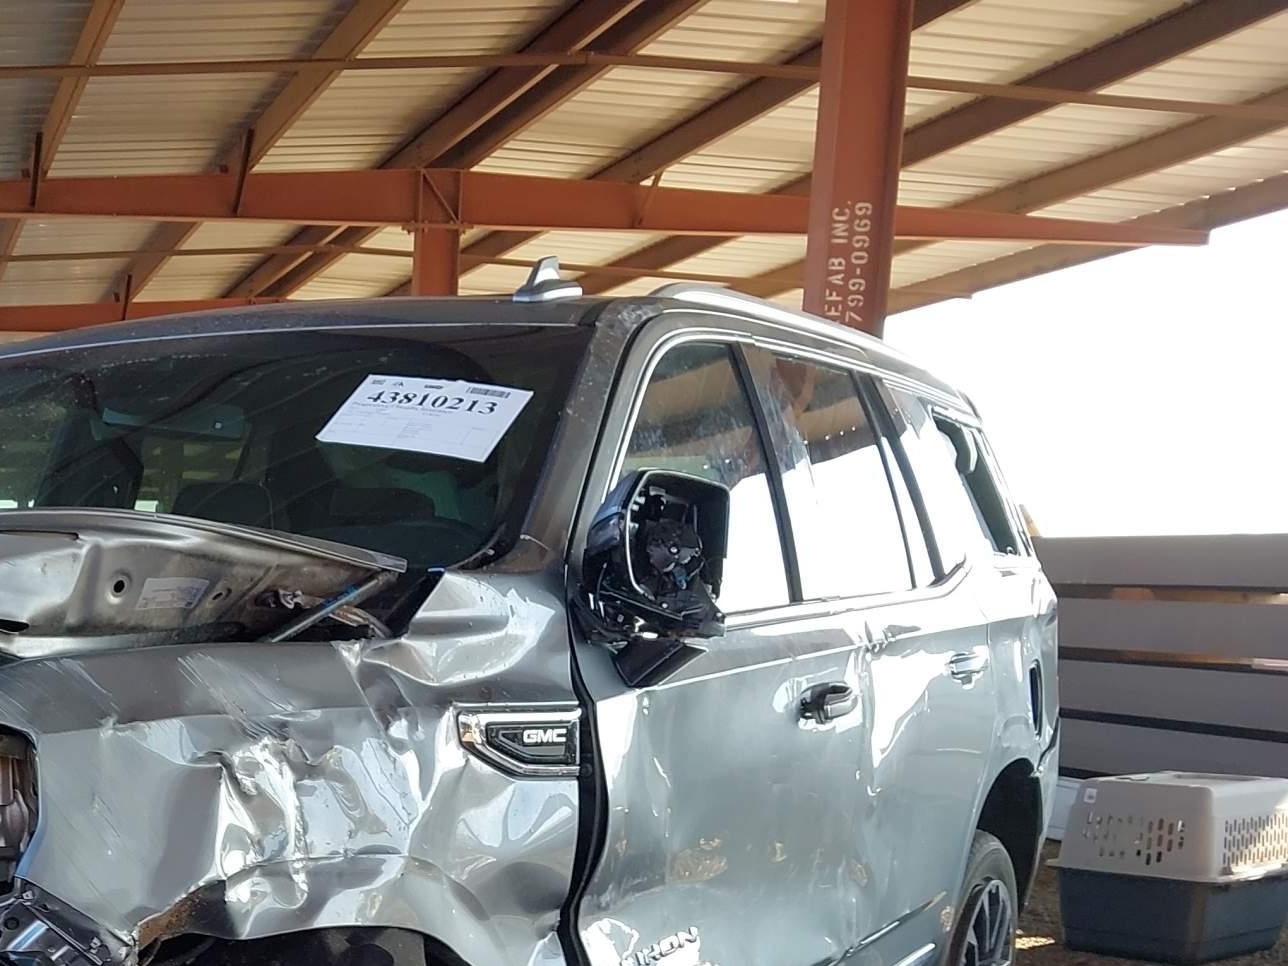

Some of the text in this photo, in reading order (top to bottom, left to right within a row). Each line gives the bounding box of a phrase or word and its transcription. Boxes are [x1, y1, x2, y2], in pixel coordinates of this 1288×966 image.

[824, 200, 852, 322] EFAB INC.
[367, 389, 498, 416] 43810213
[523, 728, 567, 743] GMC
